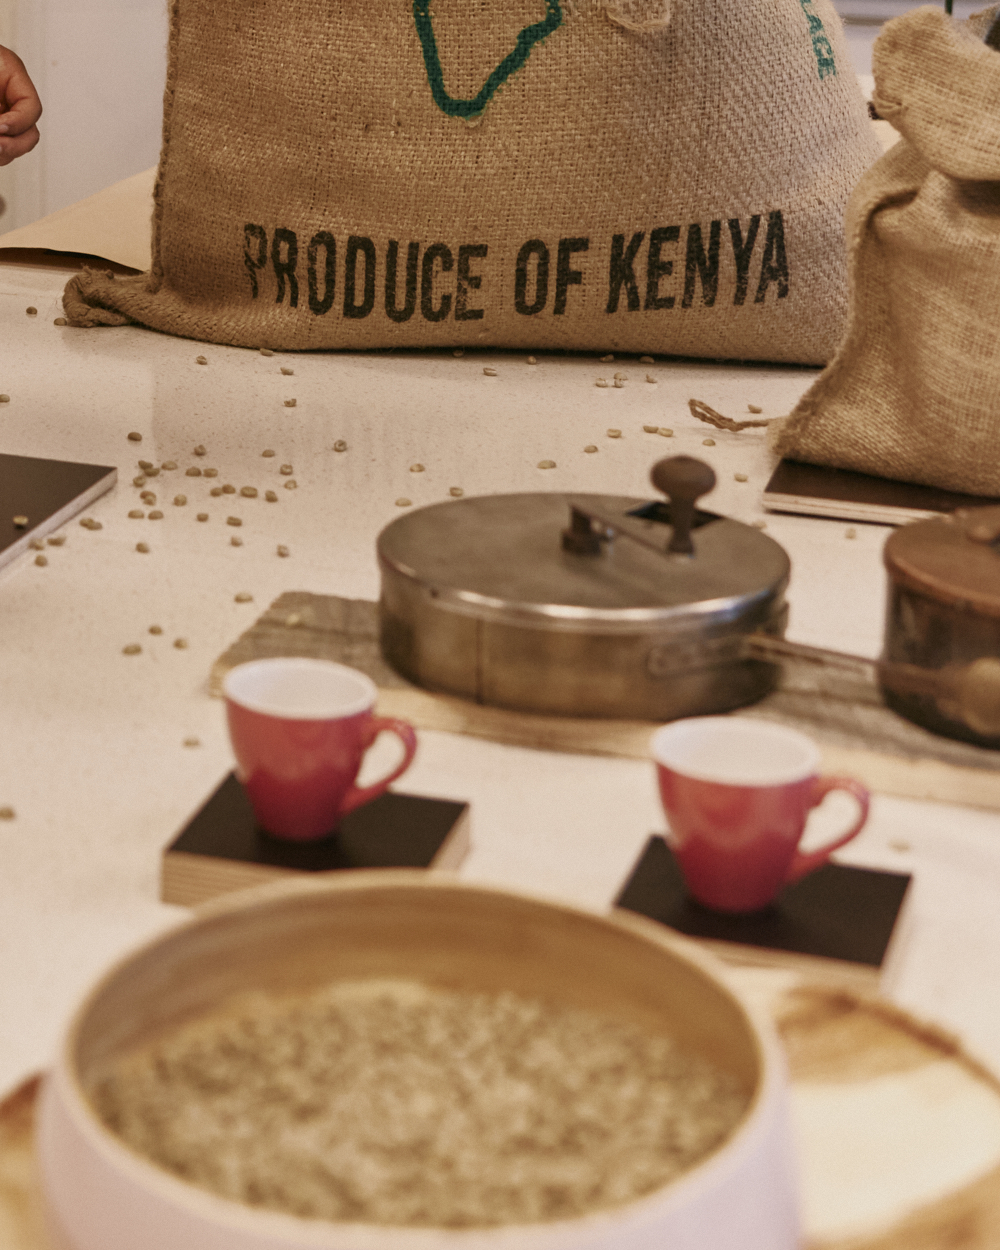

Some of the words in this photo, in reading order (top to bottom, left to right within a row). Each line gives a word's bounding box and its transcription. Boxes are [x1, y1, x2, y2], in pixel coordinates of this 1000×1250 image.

[243, 223, 489, 323] PRODUCE
[514, 238, 590, 316] OF
[605, 209, 790, 314] KENYA
